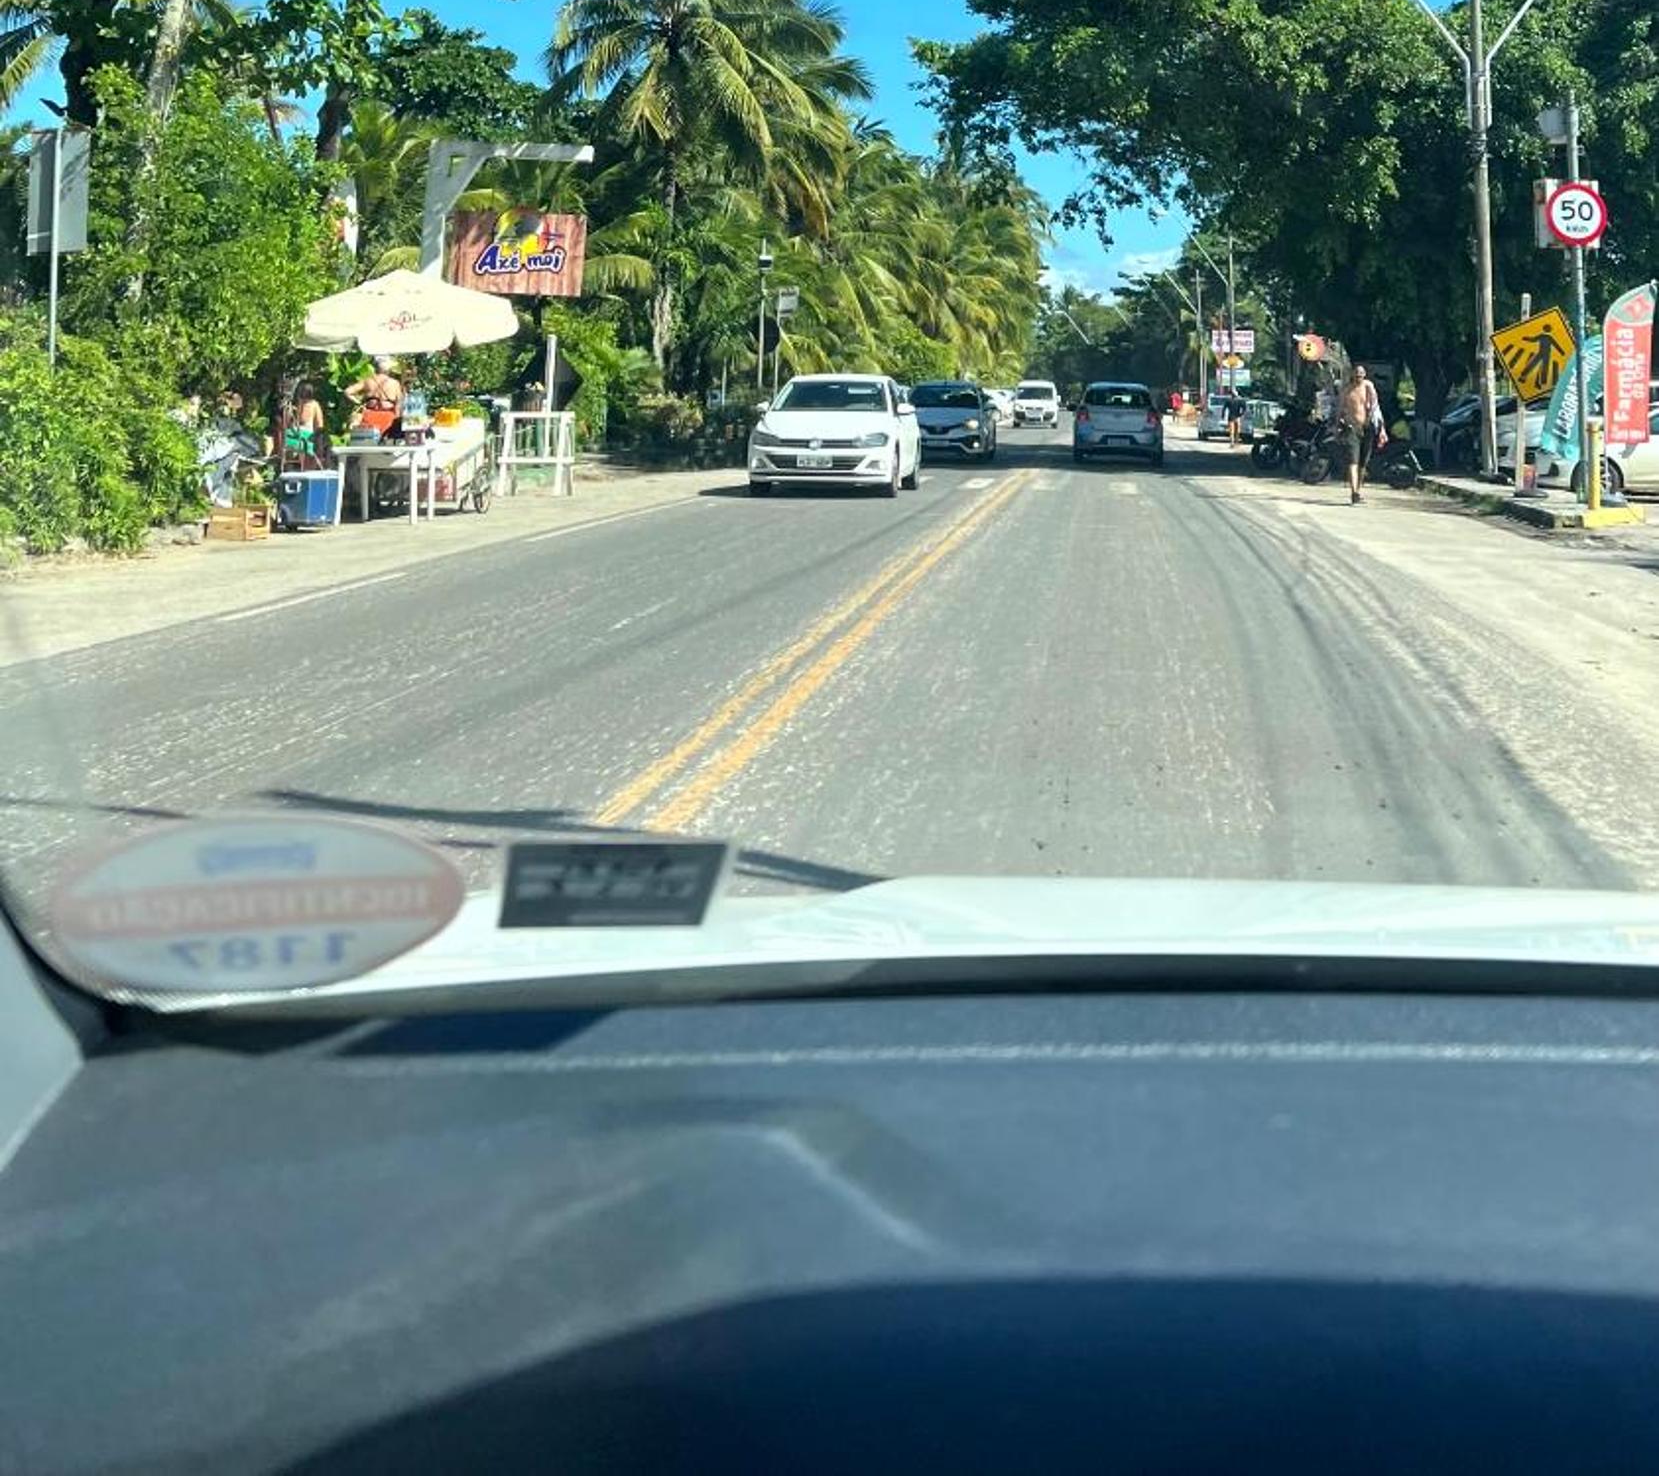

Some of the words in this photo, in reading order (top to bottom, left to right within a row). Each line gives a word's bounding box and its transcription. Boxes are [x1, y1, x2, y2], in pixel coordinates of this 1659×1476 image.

[1560, 200, 1593, 221] 50
[475, 243, 520, 272] Axé
[1610, 328, 1636, 422] Farmácia
